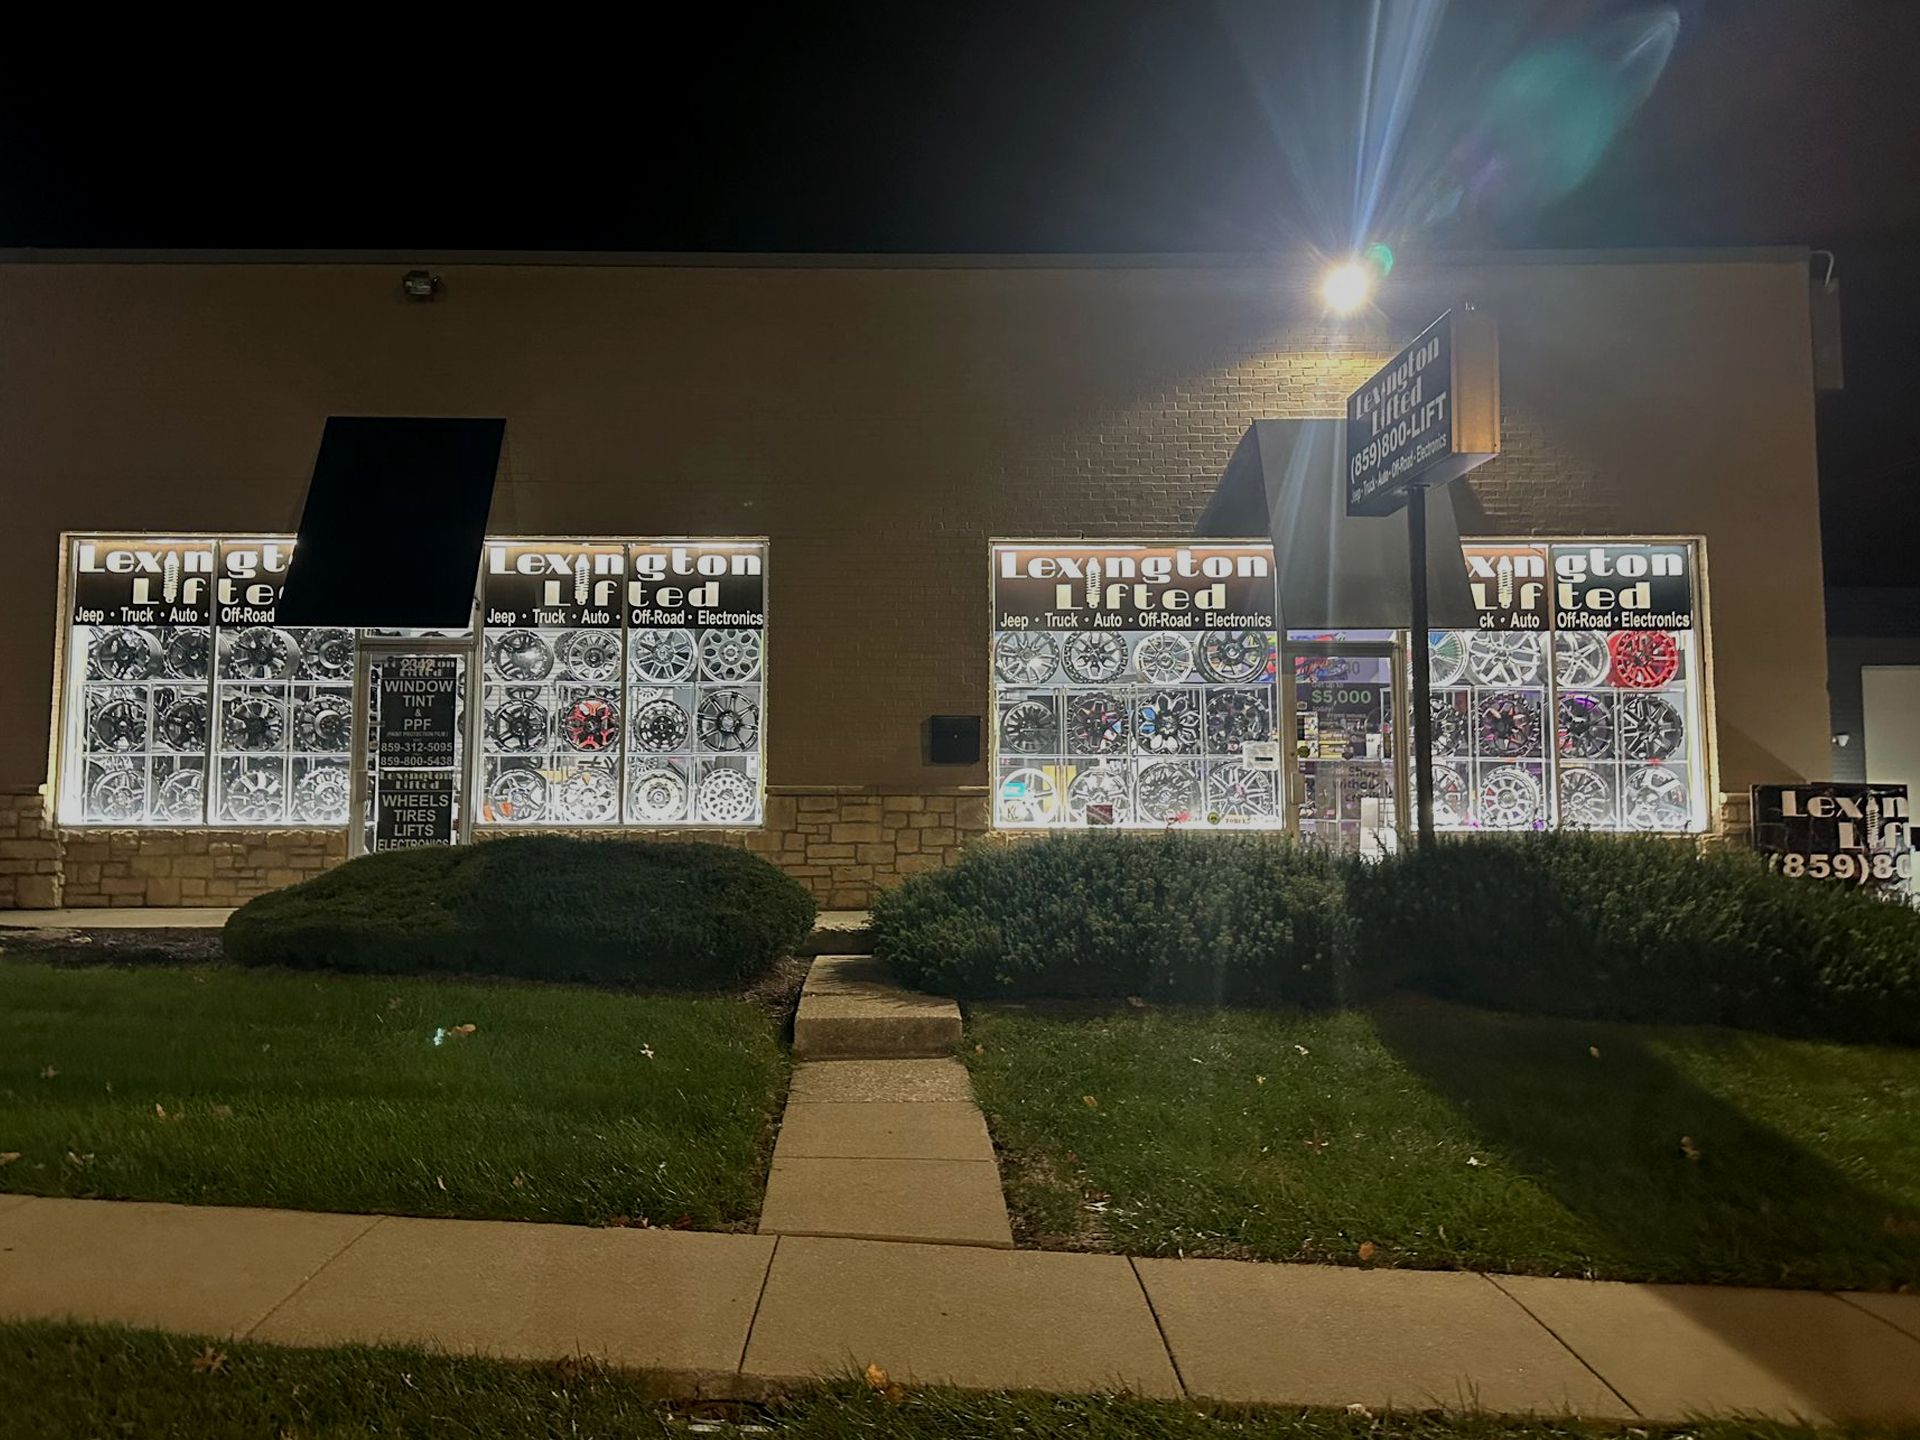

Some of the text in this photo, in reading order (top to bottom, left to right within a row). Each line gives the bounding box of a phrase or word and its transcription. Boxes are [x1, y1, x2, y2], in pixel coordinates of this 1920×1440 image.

[1356, 337, 1439, 420] Lexington
[1372, 375, 1422, 436] Lifted
[1351, 391, 1447, 484] (859)800-LIFT
[1416, 433, 1447, 463] Electronics
[78, 544, 293, 579] Lexingt
[489, 547, 761, 581] Lexington
[1000, 550, 1268, 584] Lexington
[1467, 549, 1683, 584] xington
[132, 577, 284, 605] Lifte
[544, 580, 720, 607] Lifted
[1056, 583, 1226, 610] Lifted
[1470, 581, 1651, 610] Lifted
[75, 606, 275, 624] Jeep Truck Auto Off-Road
[487, 608, 764, 626] Jeep Truck Auto Off-Road Electronics
[1000, 612, 1272, 630] Jeep Truck Auto Off-Road Electronics
[1510, 612, 1540, 628] Auto
[1557, 611, 1612, 628] Off-Road
[1621, 611, 1690, 628] Electronics
[384, 680, 454, 693] WINDOW
[402, 695, 435, 708] TINT
[1311, 690, 1372, 706] $5,000
[414, 708, 422, 718] &
[403, 718, 432, 731] PPF
[381, 742, 453, 752] 859-312-5095
[380, 756, 453, 766] 859-800-5438
[382, 794, 449, 807] WHEELS
[1781, 790, 1909, 819] Lexin
[394, 809, 436, 822] TIRES
[394, 824, 434, 837] LIFTS
[377, 838, 450, 851] ELECTRONICS
[1769, 852, 1912, 885] (859)80
